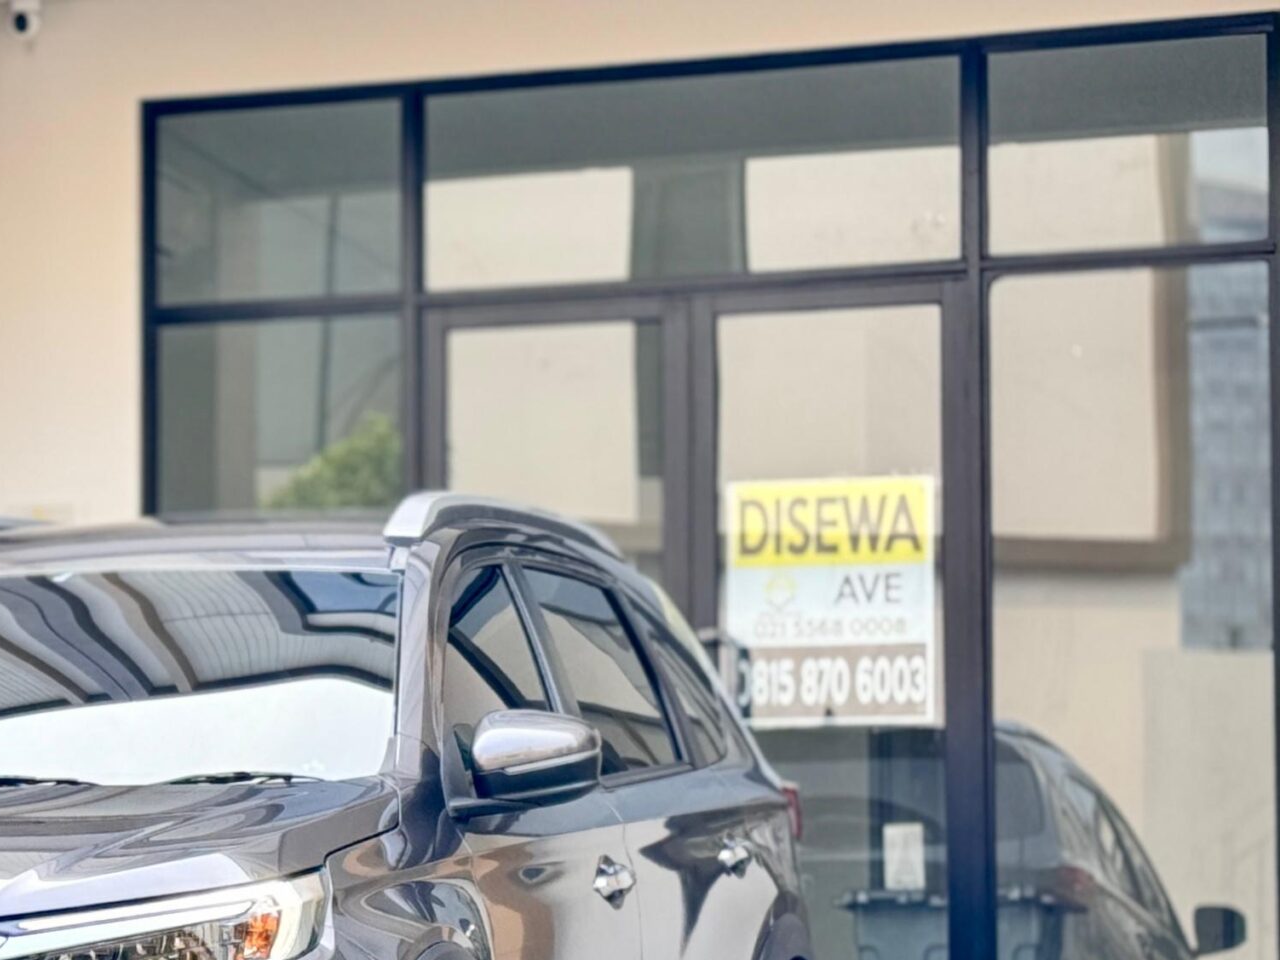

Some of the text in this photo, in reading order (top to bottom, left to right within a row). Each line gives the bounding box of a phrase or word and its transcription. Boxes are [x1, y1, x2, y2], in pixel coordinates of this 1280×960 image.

[738, 494, 923, 557] DISEWA
[833, 572, 903, 605] AVE
[800, 655, 851, 706] 870
[855, 654, 926, 704] 6003
